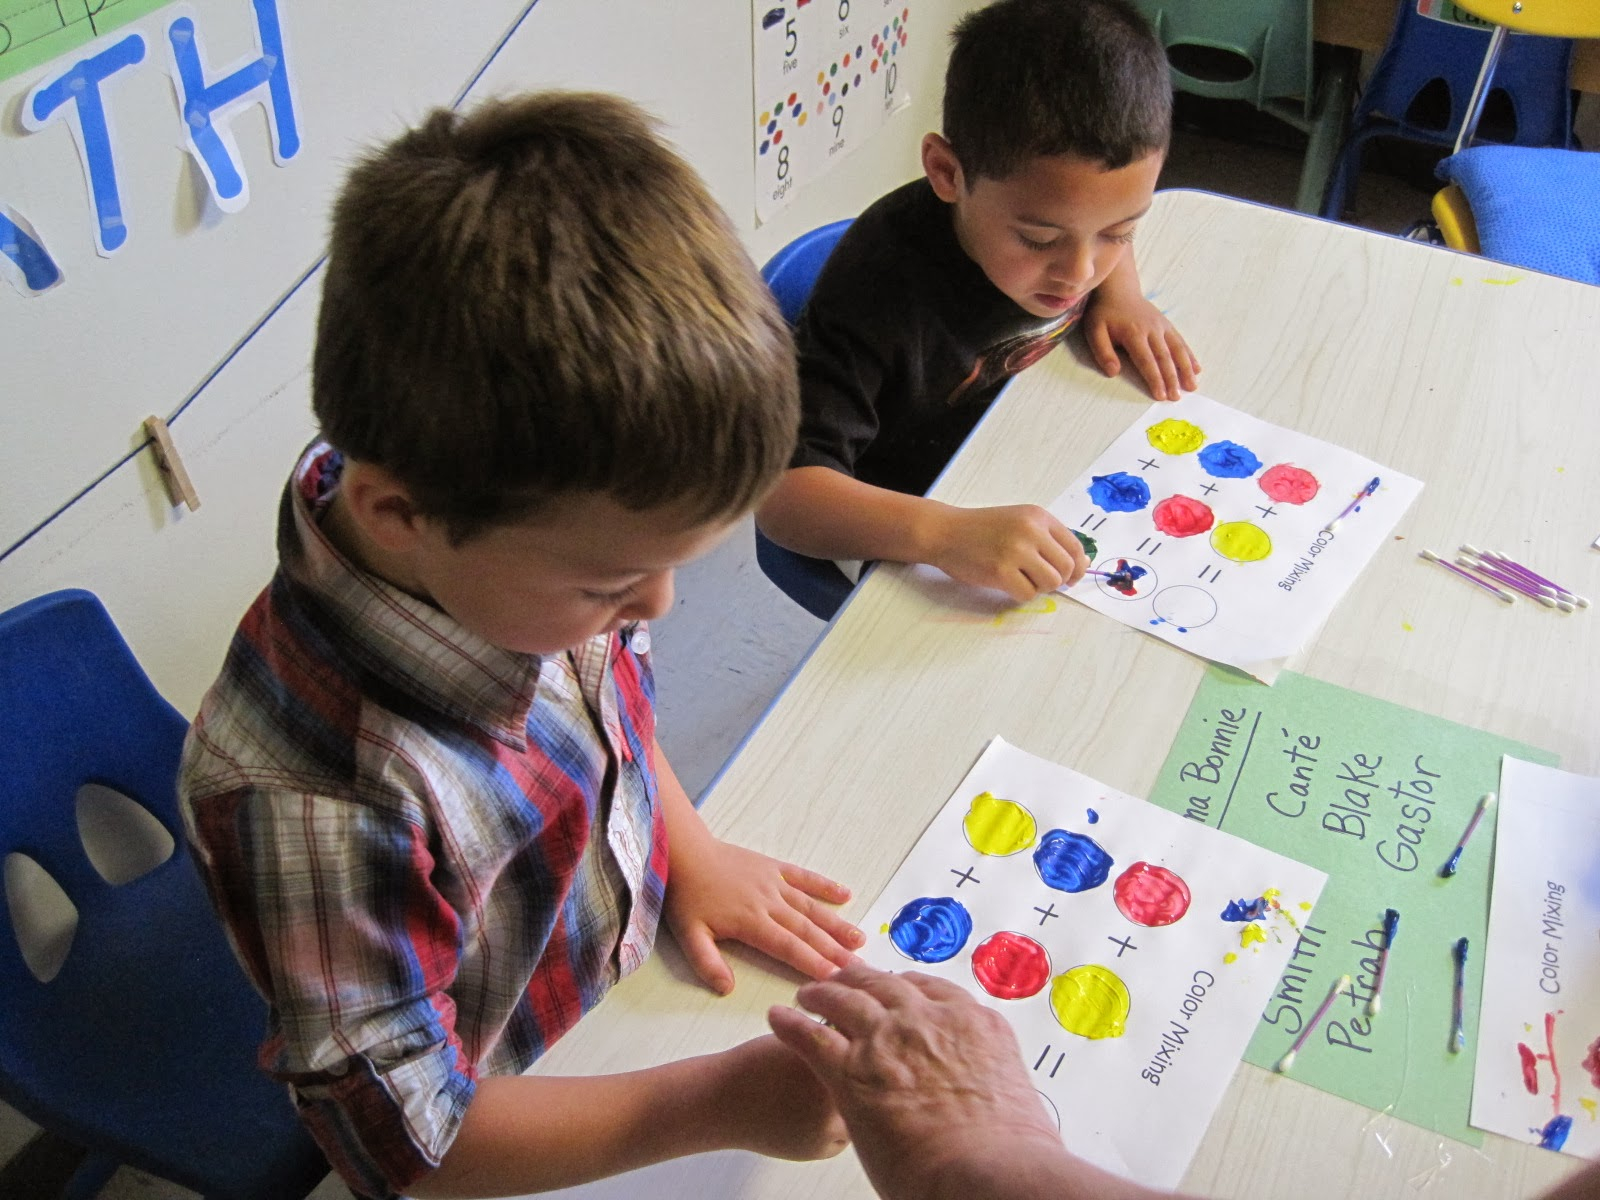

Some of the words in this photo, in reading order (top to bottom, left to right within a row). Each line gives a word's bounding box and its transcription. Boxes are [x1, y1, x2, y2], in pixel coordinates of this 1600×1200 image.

[785, 18, 797, 57] 5
[782, 59, 798, 75] five
[884, 63, 897, 99] 10
[0, 0, 300, 291] TH
[832, 105, 844, 138] 9
[777, 145, 789, 180] 8
[772, 177, 793, 200] eight
[1308, 529, 1335, 558] Color
[1278, 557, 1315, 592] Mixing
[1180, 708, 1247, 785] Bonnie
[1266, 727, 1321, 818] Canté
[1322, 753, 1383, 840] Blake
[1376, 754, 1441, 872] Gastor
[1541, 880, 1566, 940] Mixing
[1539, 943, 1561, 995] Color
[1179, 970, 1215, 1020] Color
[1141, 1020, 1190, 1087] Mixing
